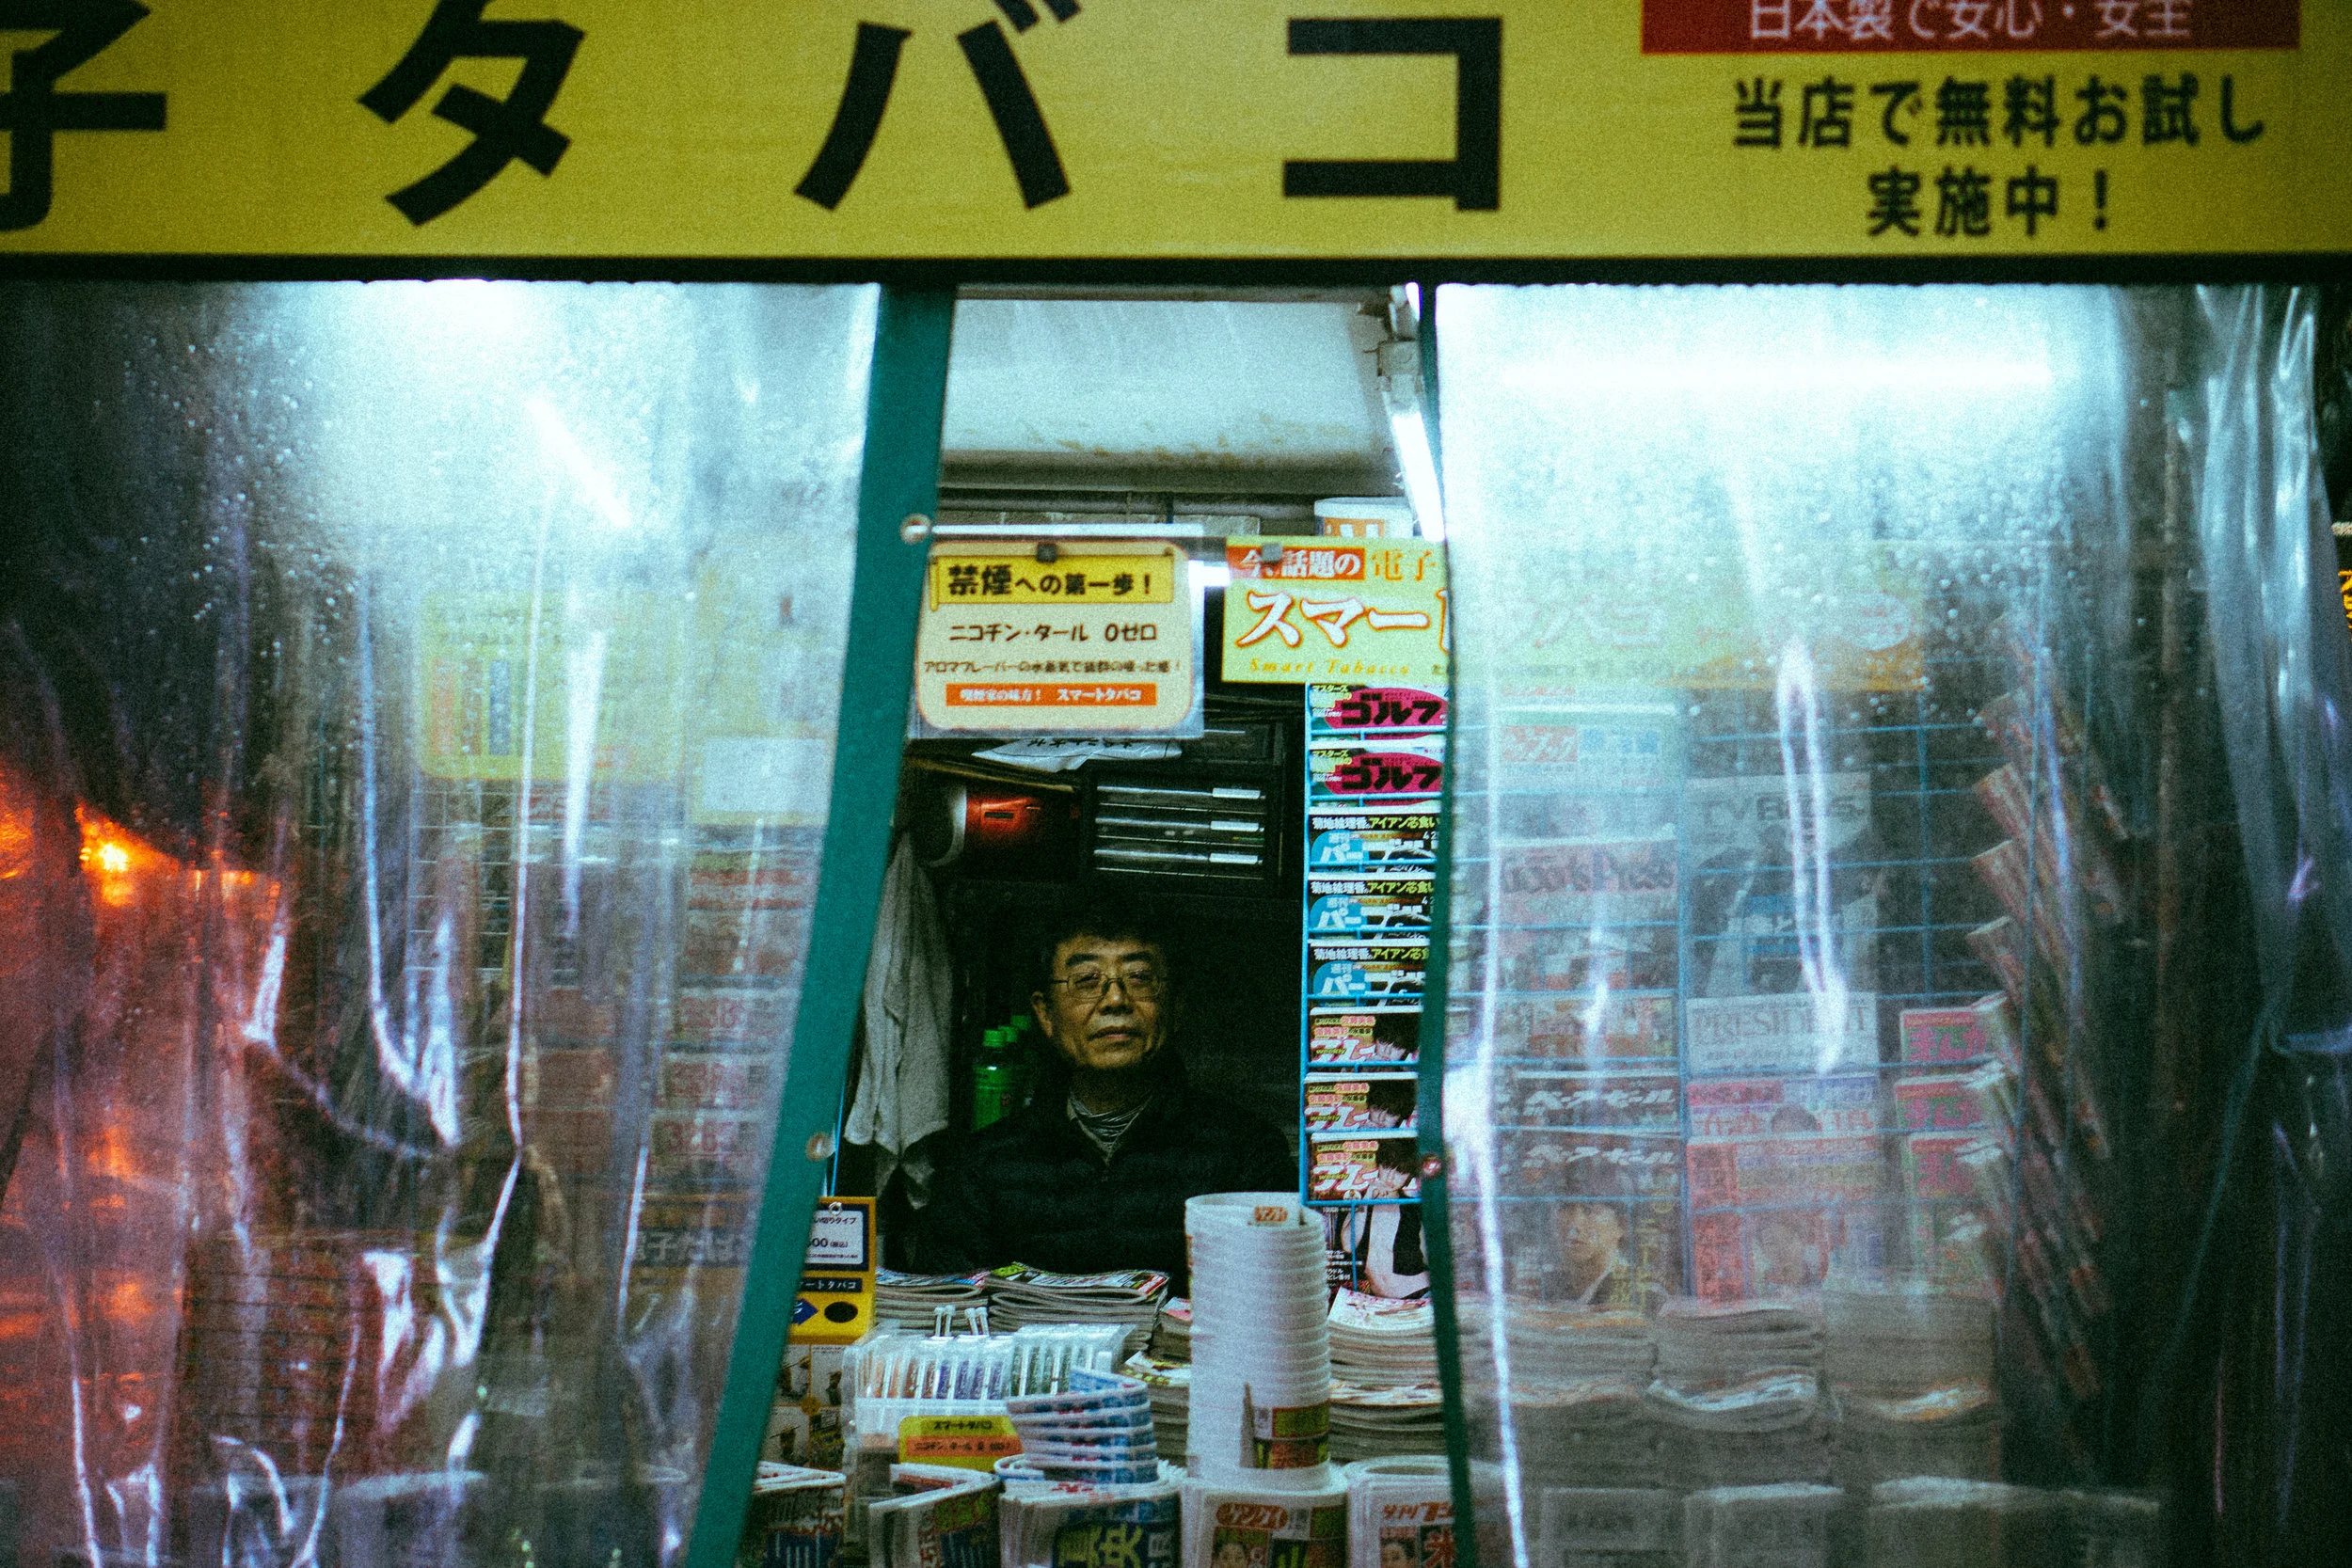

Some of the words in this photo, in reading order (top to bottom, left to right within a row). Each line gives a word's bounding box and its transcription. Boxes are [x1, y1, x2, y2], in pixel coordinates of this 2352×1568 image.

[1734, 74, 2265, 148] 当店で無料お試し
[1867, 166, 2110, 238] 実施中！
[948, 564, 1152, 595] 禁煙への第一歩！
[949, 624, 1089, 642] ニコチン・タール
[1249, 657, 1313, 673] Smart
[1057, 688, 1142, 702] スマートタバコ
[1341, 692, 1442, 725] ゴルフ
[1341, 757, 1442, 790] ゴルフ
